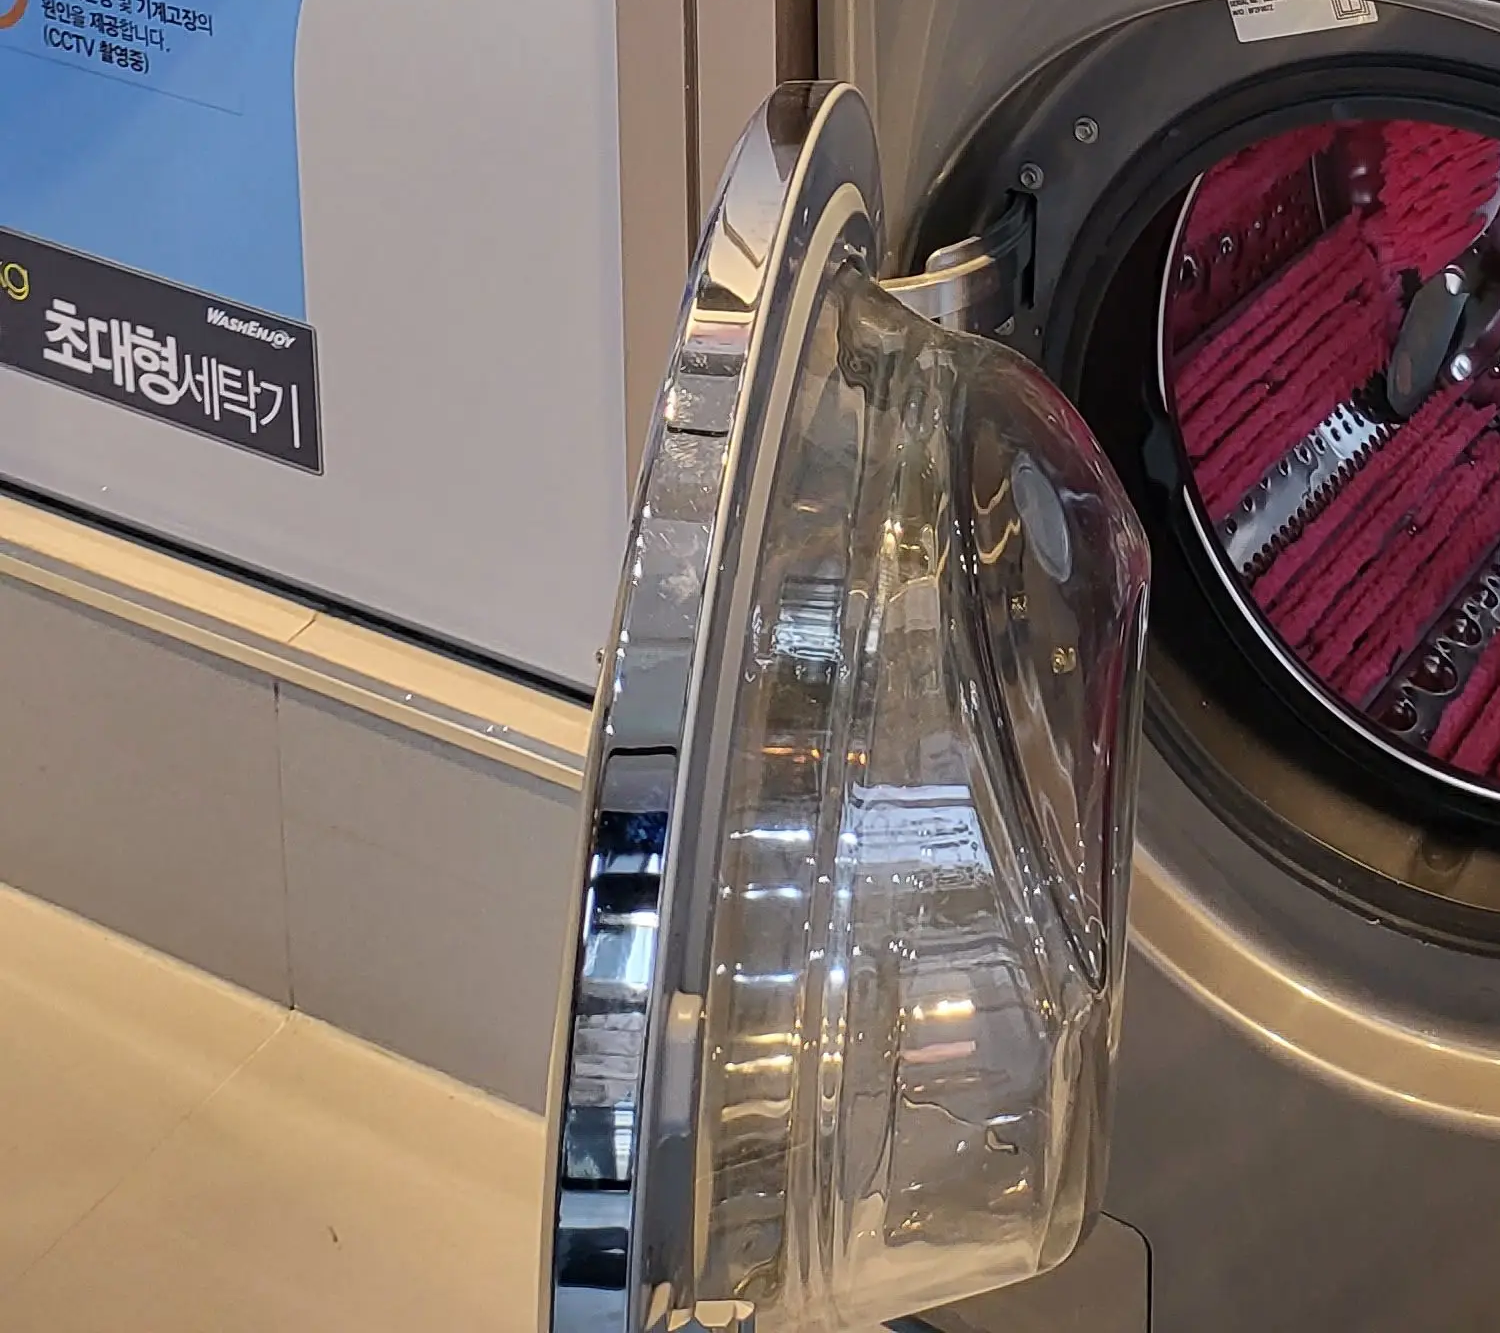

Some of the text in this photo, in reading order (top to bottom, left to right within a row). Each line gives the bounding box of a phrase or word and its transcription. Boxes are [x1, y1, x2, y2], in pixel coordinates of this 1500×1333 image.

[43, 27, 150, 74] (CCTV 촬영중)
[89, 11, 171, 53] 제공합니다.
[43, 298, 300, 449] 초대형세탁기
